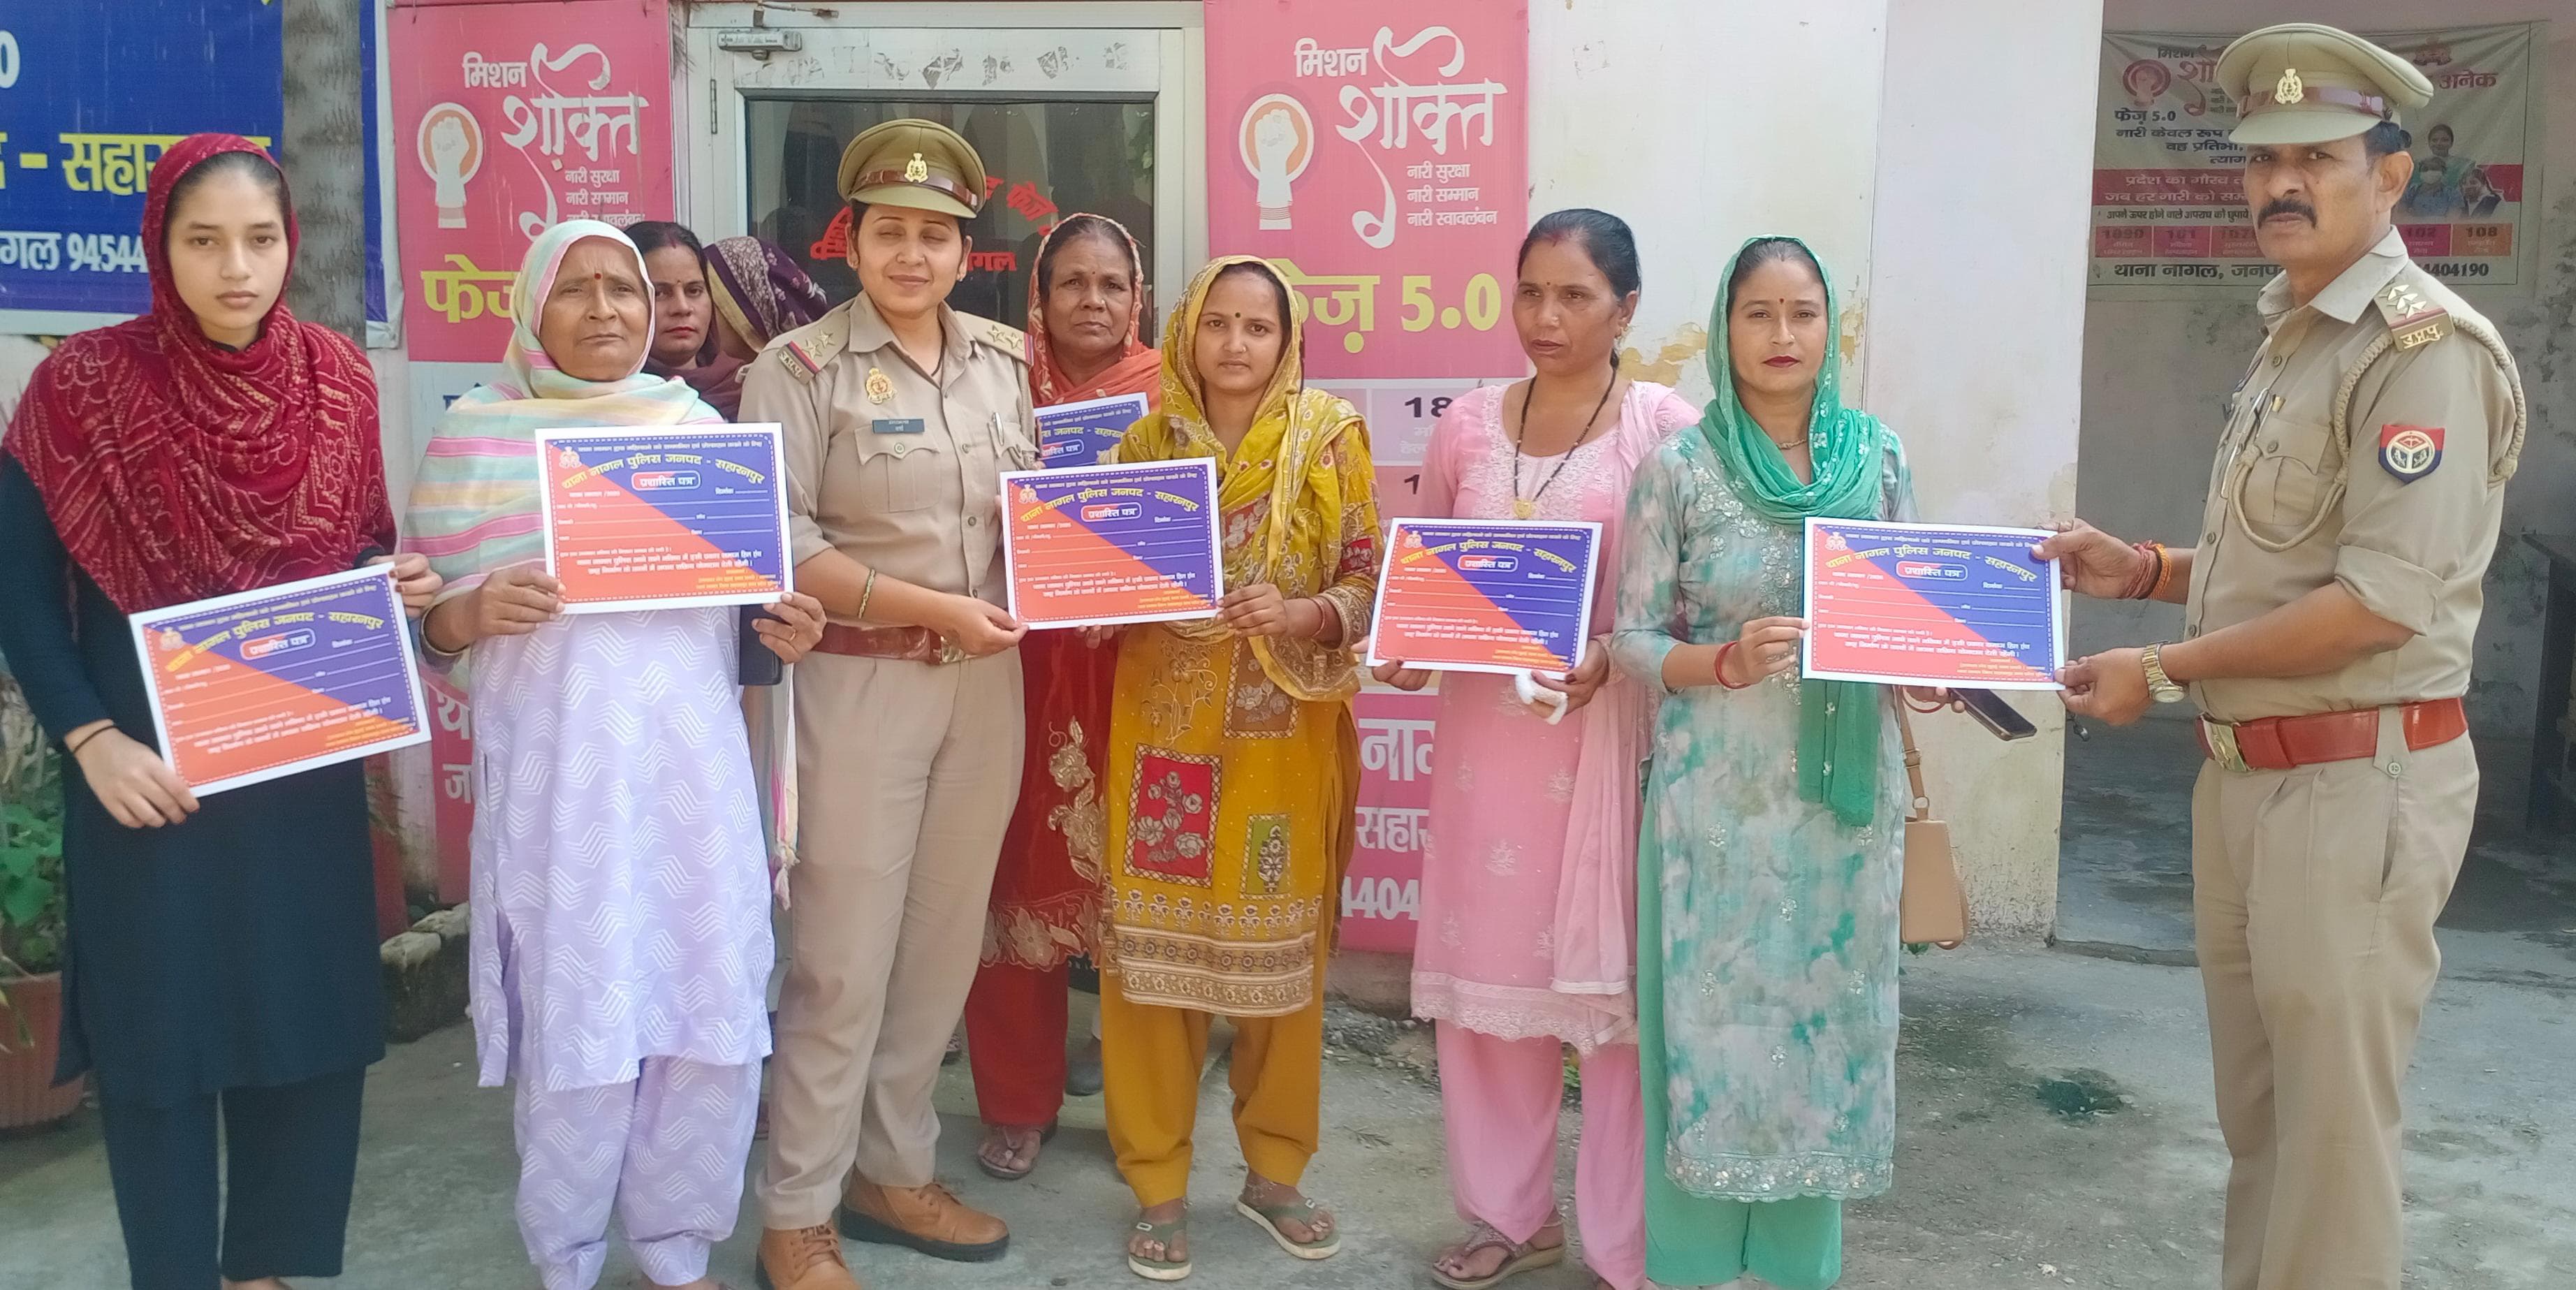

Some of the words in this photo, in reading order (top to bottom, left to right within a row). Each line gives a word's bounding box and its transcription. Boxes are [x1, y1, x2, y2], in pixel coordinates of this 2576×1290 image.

[1294, 38, 1369, 78] मिशन
[462, 52, 527, 88] मिशन
[2439, 71, 2498, 89] अनेक
[2151, 110, 2176, 122] 5.0
[1336, 26, 1508, 249] शक्ति
[2116, 126, 2146, 138] नारी
[2151, 127, 2193, 138] केवल
[2196, 129, 2225, 138] रूप
[564, 166, 587, 183] नारी
[590, 170, 620, 188] सुरक्षा
[1407, 160, 1433, 179] नारी
[1435, 163, 1471, 183] सुरक्षा
[2125, 173, 2160, 186] प्रदेश
[2165, 176, 2186, 185] का
[566, 188, 588, 205] नारी
[1407, 184, 1433, 203] नारी
[1436, 187, 1479, 202] सम्मान
[2105, 192, 2130, 202] जब
[2135, 192, 2156, 202] हर
[2159, 189, 2190, 201] नारी
[2195, 190, 2215, 202] को
[1407, 209, 1433, 226] नारी
[1436, 206, 1498, 226] स्वावलंबन
[2114, 265, 2157, 277] थाना
[2162, 265, 2224, 279] नागल,
[2231, 265, 2285, 277] जनप
[1400, 272, 1502, 332] 5.0
[1404, 397, 1453, 418] 18
[589, 459, 624, 476] नागल
[627, 453, 661, 469] पुलिस
[665, 453, 703, 465] जनपद
[715, 458, 766, 485] सहारनपुर
[678, 476, 696, 486] पत्र
[1044, 494, 1076, 511] नागल
[1077, 488, 1108, 503] पुलिस
[1111, 488, 1144, 497] जनपद
[1155, 490, 1199, 512] सहारनपुर
[1121, 508, 1138, 516] पत्र
[1425, 543, 1456, 556] नागल
[1459, 538, 1490, 552] पुलिस
[1491, 541, 1525, 552] जनपद
[1533, 548, 1577, 573] सहारनपुर
[1826, 555, 1852, 568] थाना
[1854, 548, 1890, 559] नागल
[1893, 544, 1929, 558] पुलिस
[1932, 548, 1973, 559] जनपद
[1984, 555, 2037, 582] सहारनपुर
[233, 618, 270, 639] पुलिस
